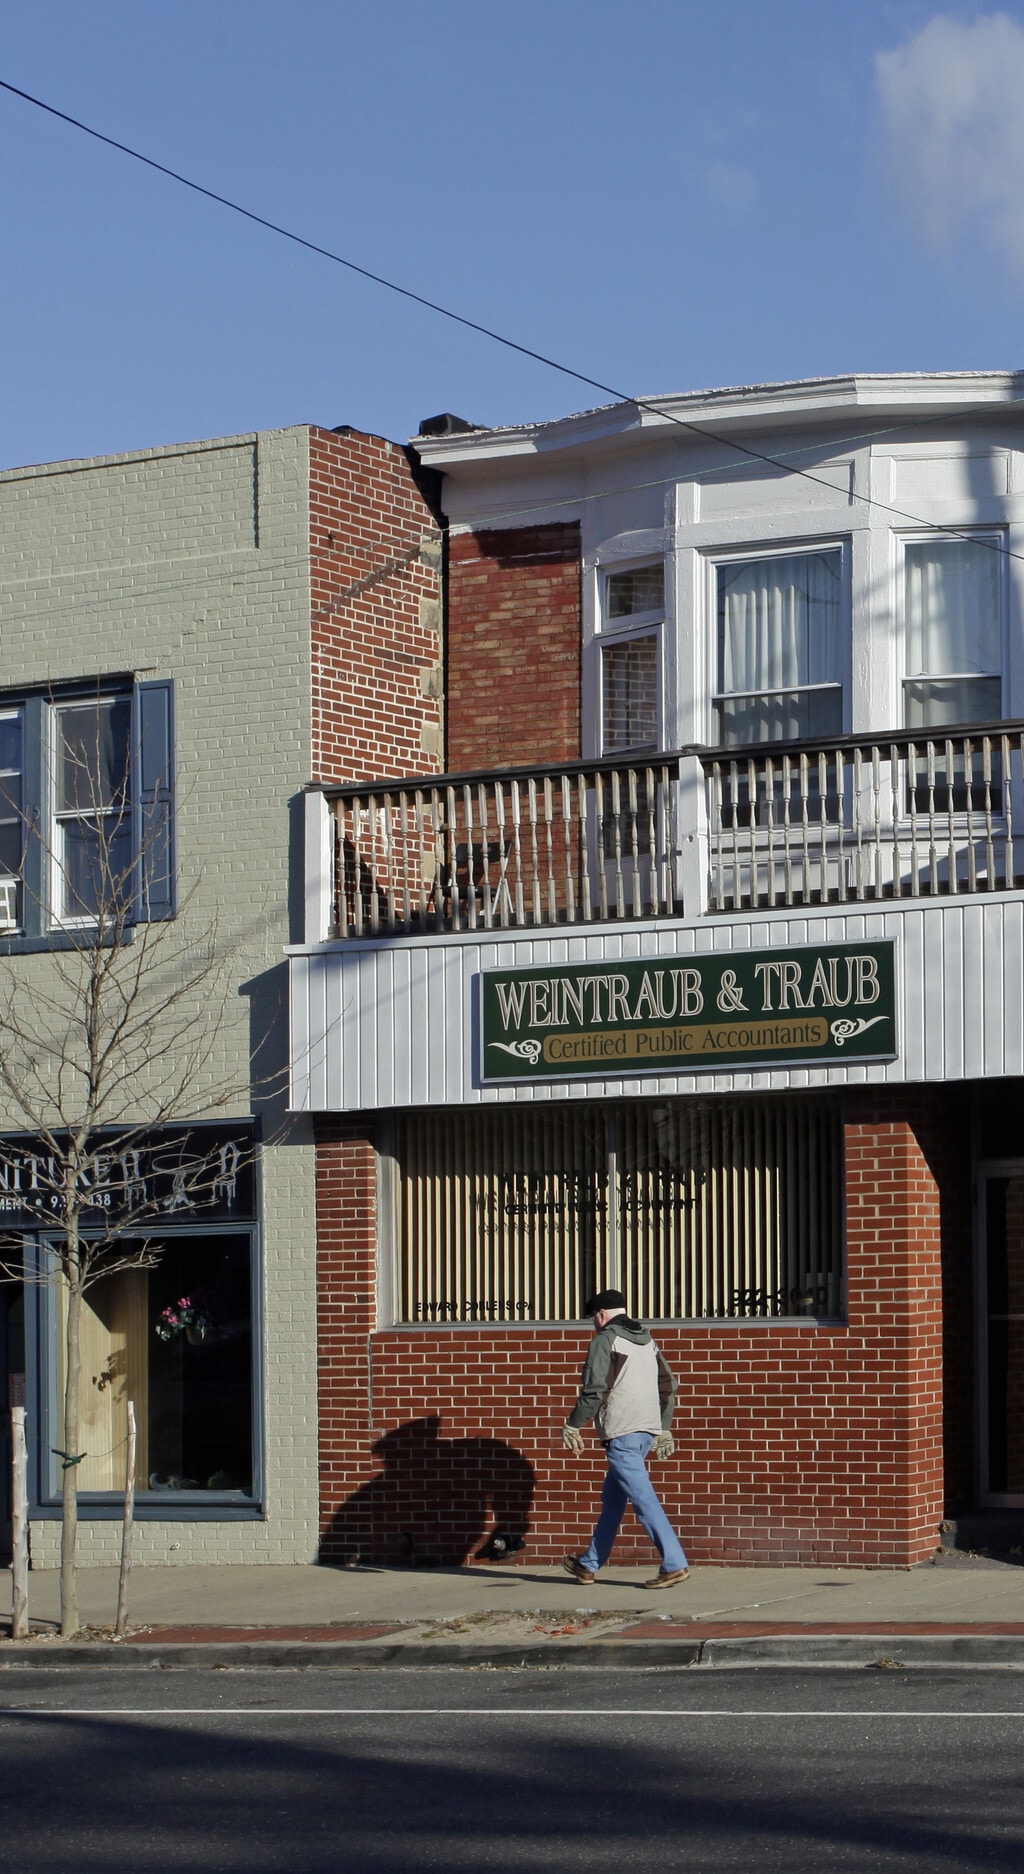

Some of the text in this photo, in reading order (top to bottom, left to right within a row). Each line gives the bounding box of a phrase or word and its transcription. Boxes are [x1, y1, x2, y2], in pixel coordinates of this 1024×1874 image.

[495, 955, 881, 1031] WEINTRAUB & TRAUB
[548, 1022, 821, 1060] Certified Public Accountants
